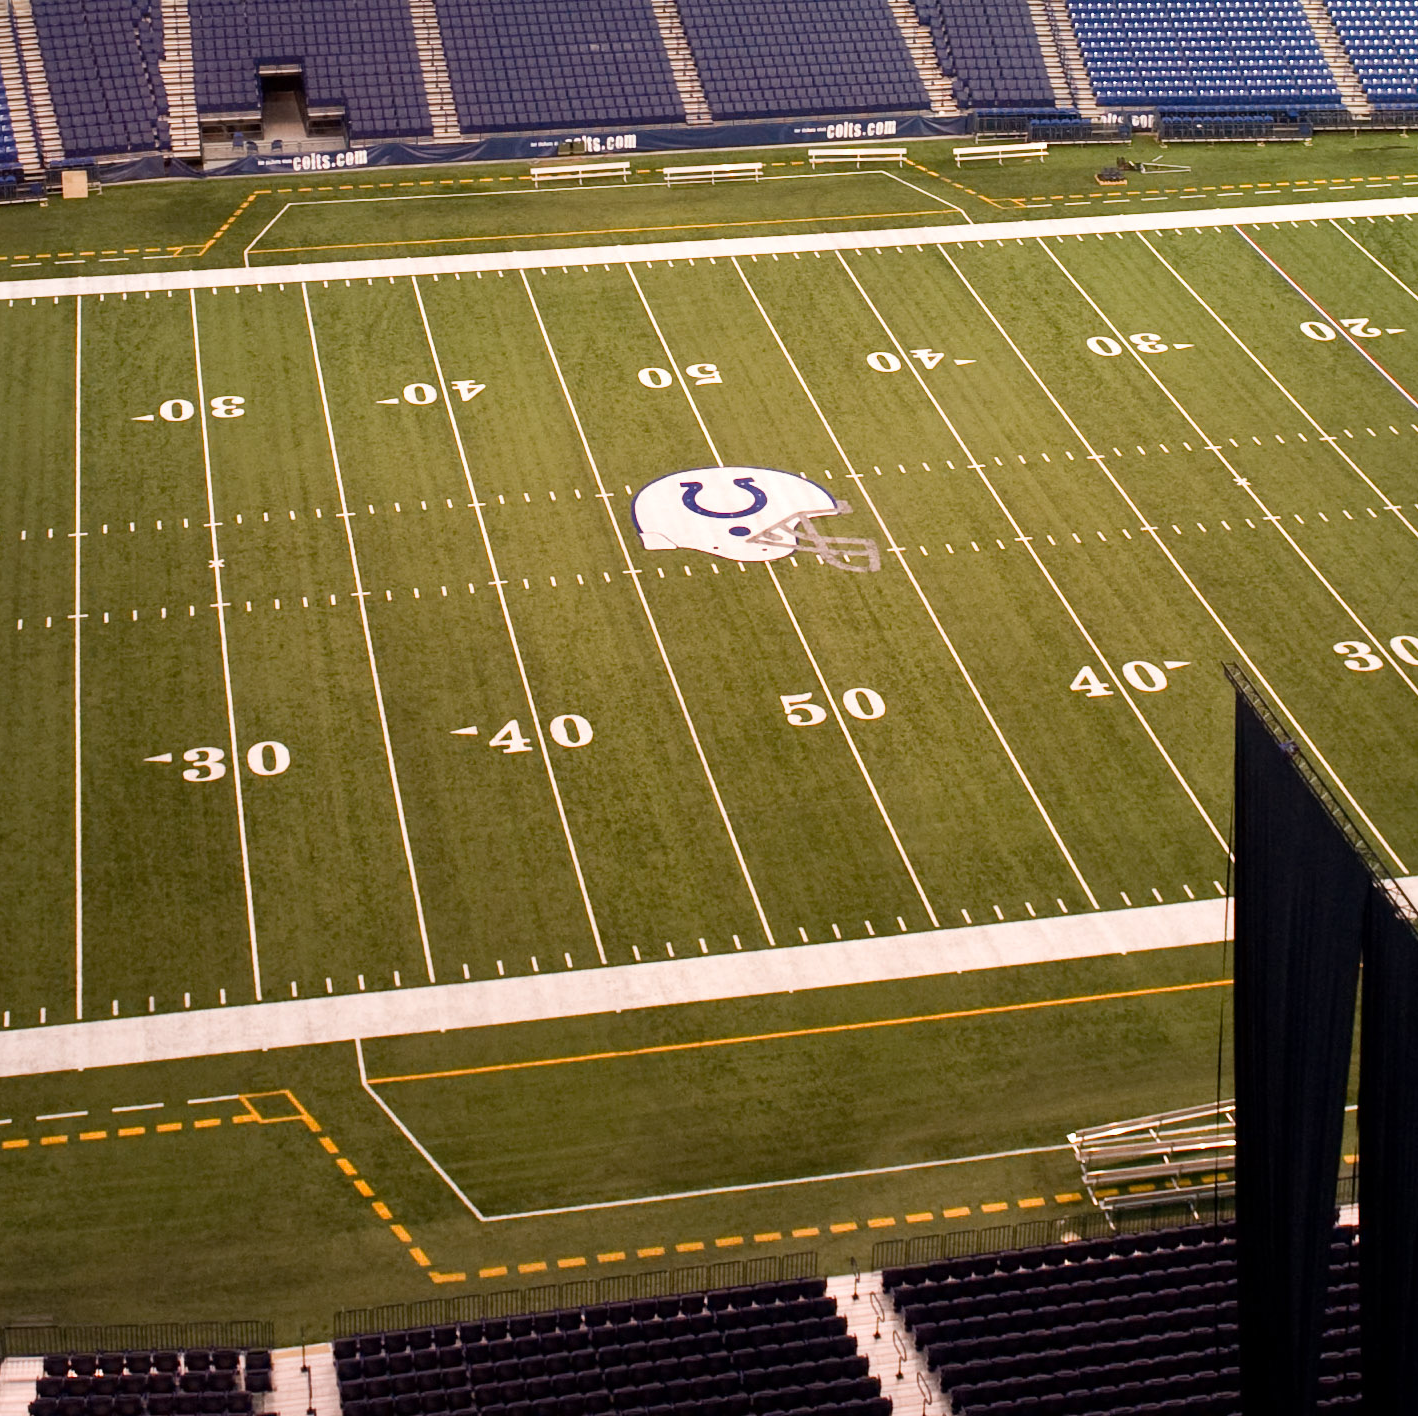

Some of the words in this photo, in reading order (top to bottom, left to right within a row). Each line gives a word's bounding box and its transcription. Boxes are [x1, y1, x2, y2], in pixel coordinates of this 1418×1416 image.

[562, 133, 637, 153] lts.com
[826, 120, 897, 140] colts.com
[292, 149, 369, 172] colts.com
[1299, 317, 1383, 342] 20
[1086, 333, 1165, 358] 30
[866, 348, 945, 373] 40
[638, 363, 722, 390] 50
[402, 379, 486, 406] 40
[158, 395, 246, 423] 30
[1070, 660, 1167, 698] 40
[780, 687, 887, 726] 50
[489, 713, 594, 755] 40
[181, 740, 291, 782] 30
